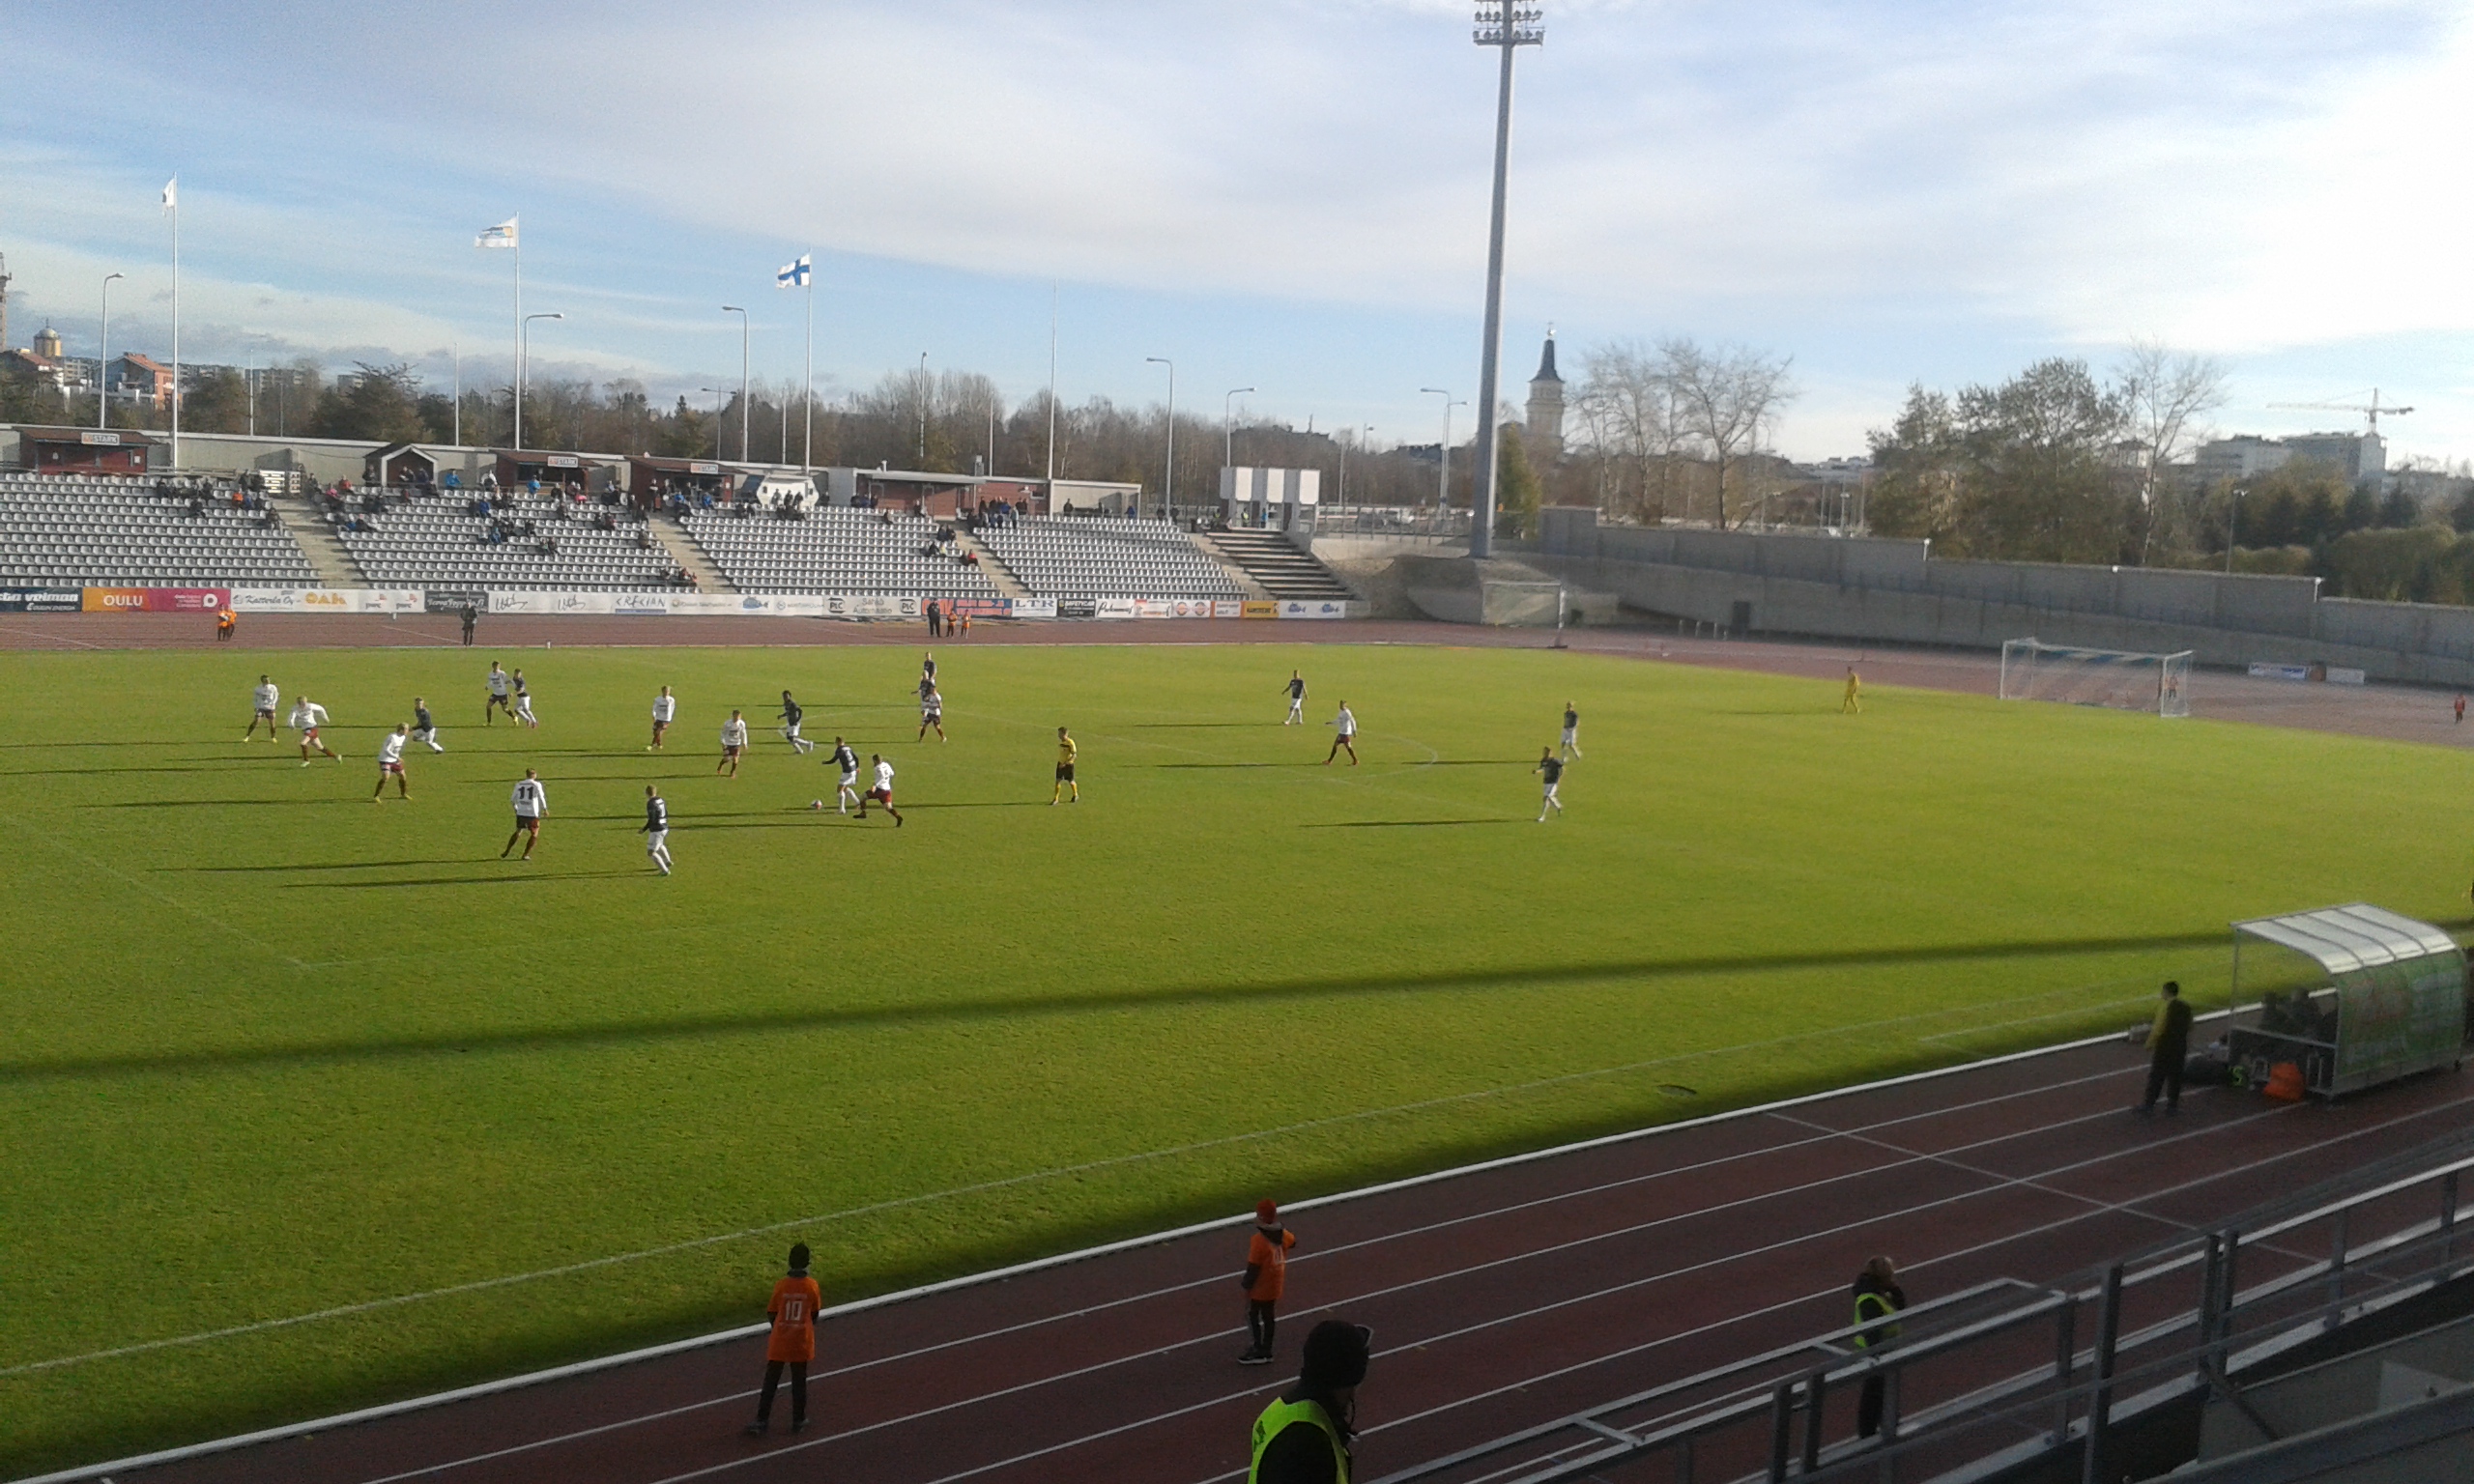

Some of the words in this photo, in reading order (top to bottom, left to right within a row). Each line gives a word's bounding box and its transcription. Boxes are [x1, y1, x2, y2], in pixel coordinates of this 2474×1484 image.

[102, 594, 144, 607] OULU
[1015, 599, 1054, 608] LTR
[518, 785, 534, 800] 11
[785, 1299, 804, 1322] 10
